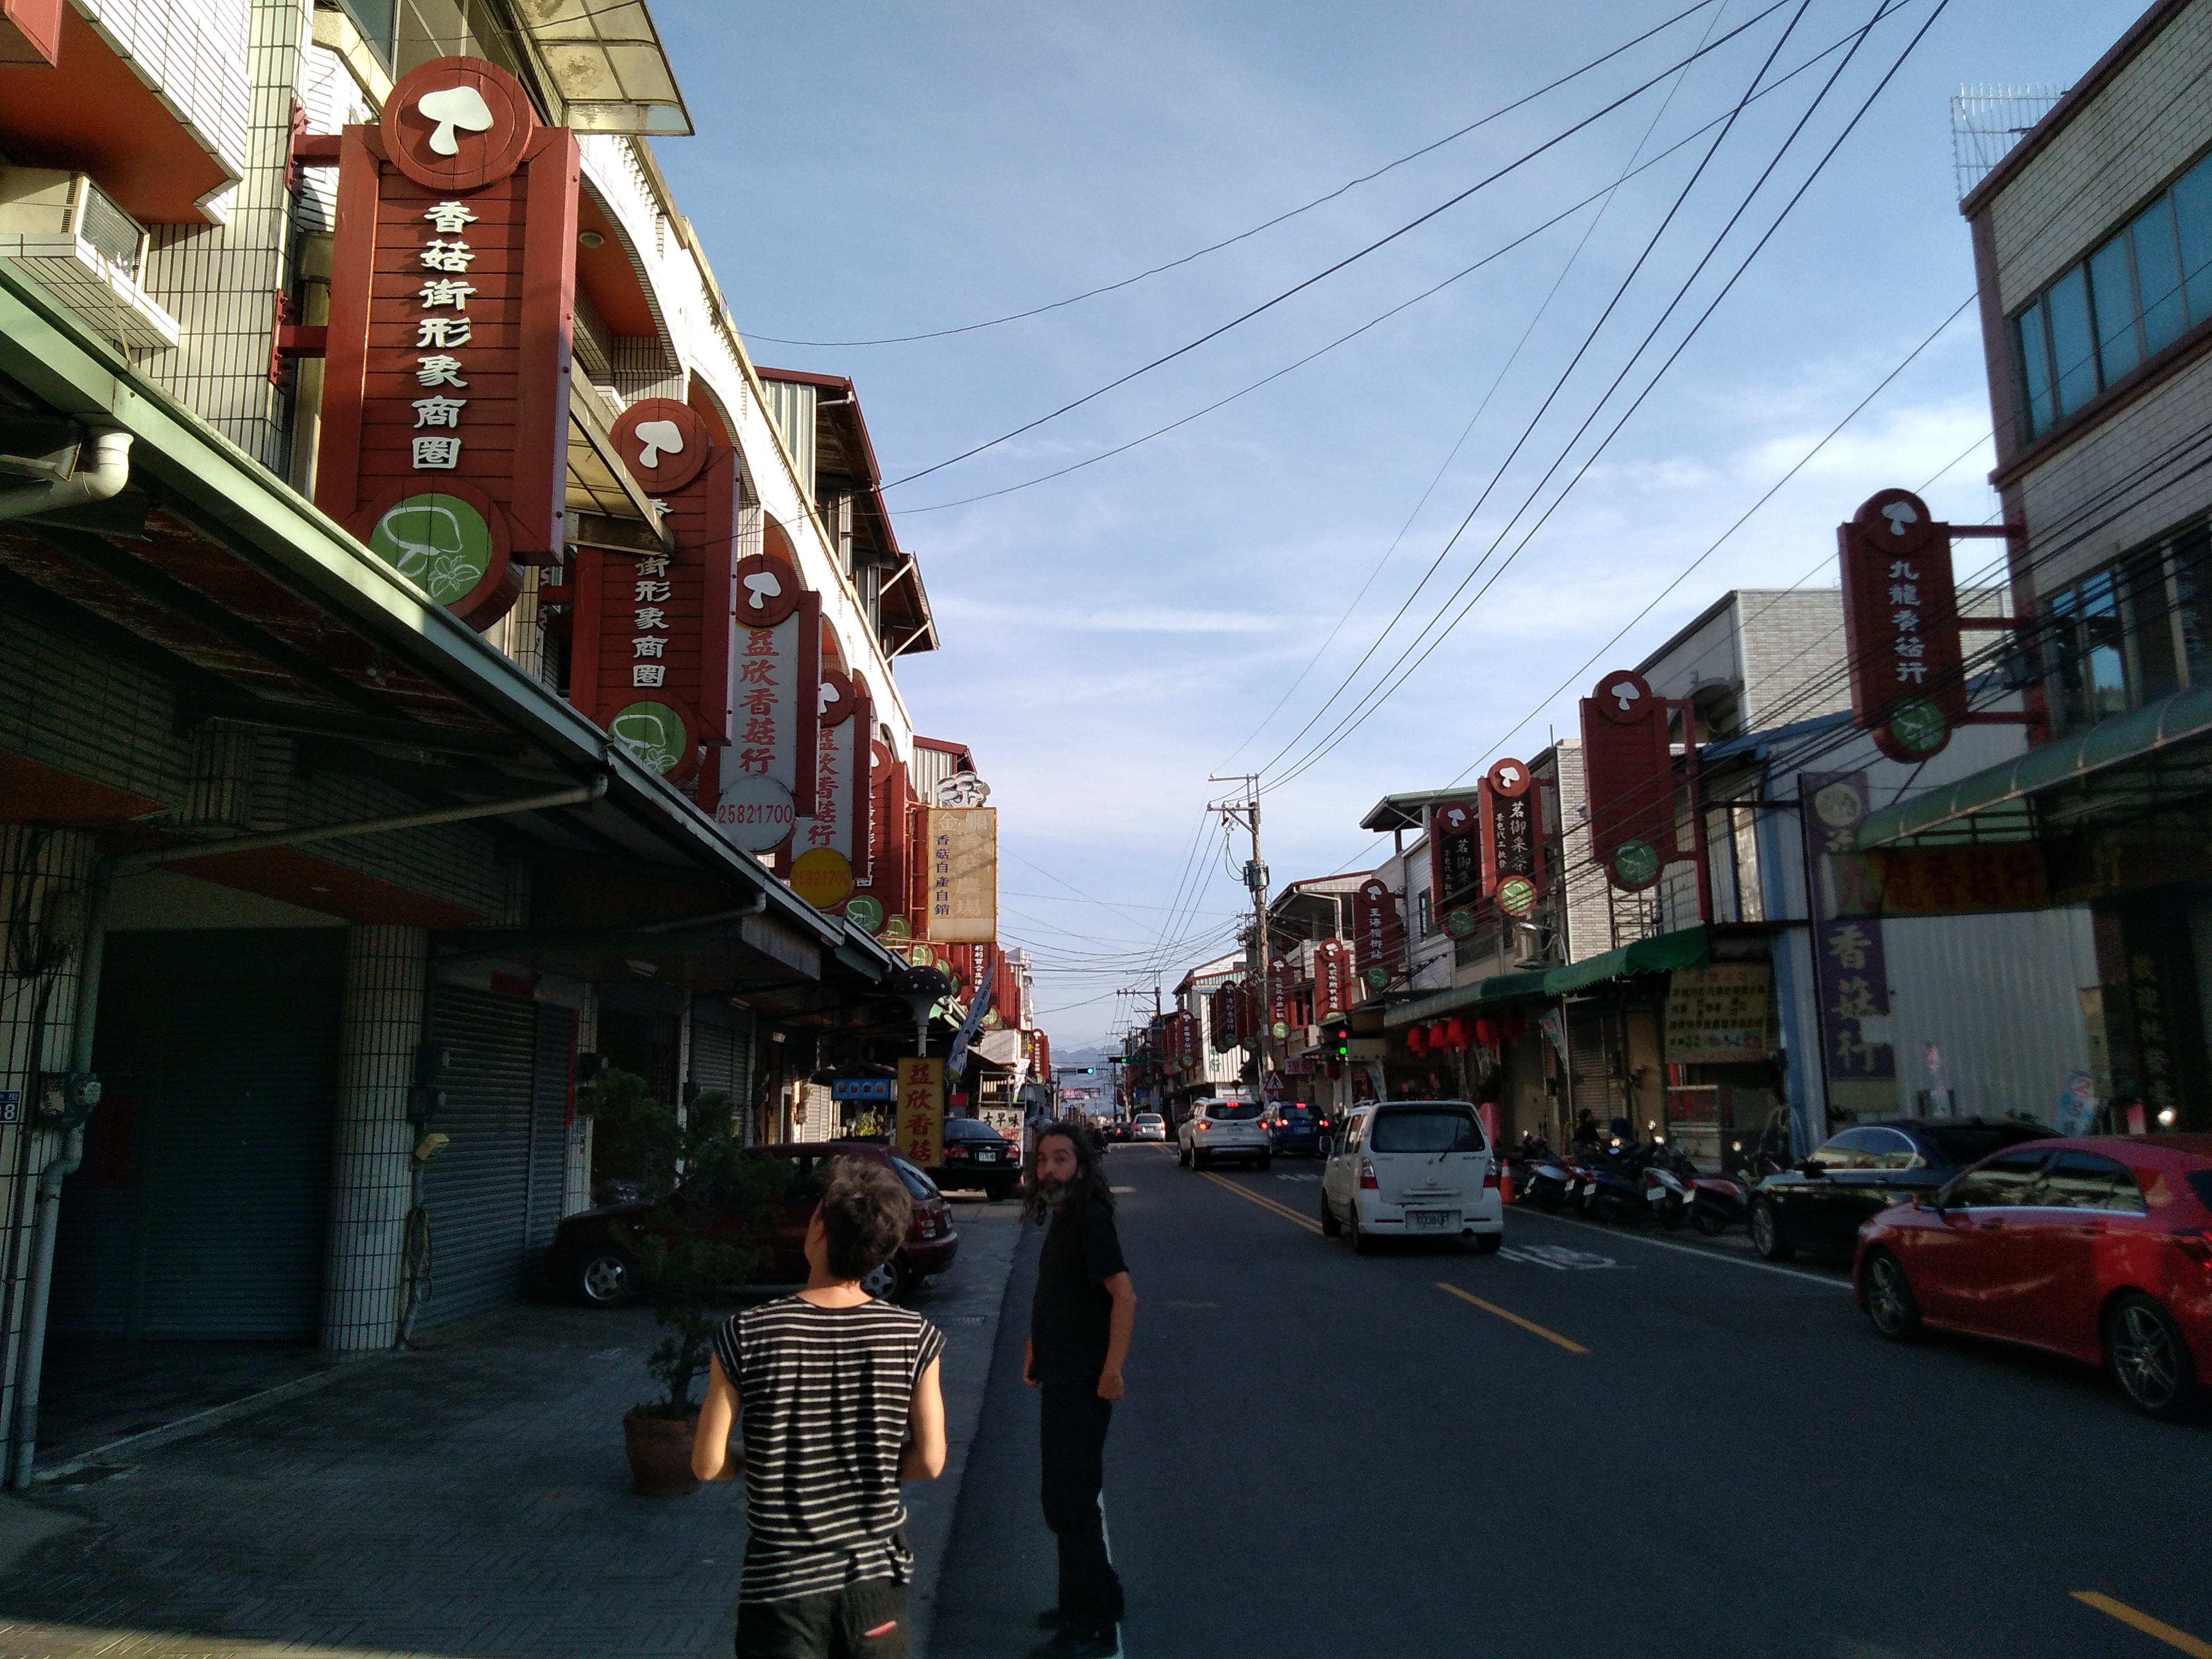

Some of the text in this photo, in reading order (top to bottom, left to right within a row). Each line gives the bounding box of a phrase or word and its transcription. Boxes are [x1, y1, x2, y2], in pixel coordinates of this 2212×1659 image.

[412, 200, 479, 470] 香菇街形象商圈
[633, 498, 674, 687] 街形象商圈
[1888, 560, 1928, 685] 九龍香菇行
[740, 630, 780, 775] 益欣香菇行
[718, 804, 792, 825] 25821700
[935, 834, 950, 916] 香菇自產自銷
[0, 1104, 15, 1120] 8
[905, 1063, 935, 1162] 益欣香菇
[983, 1111, 1020, 1128] 古早味
